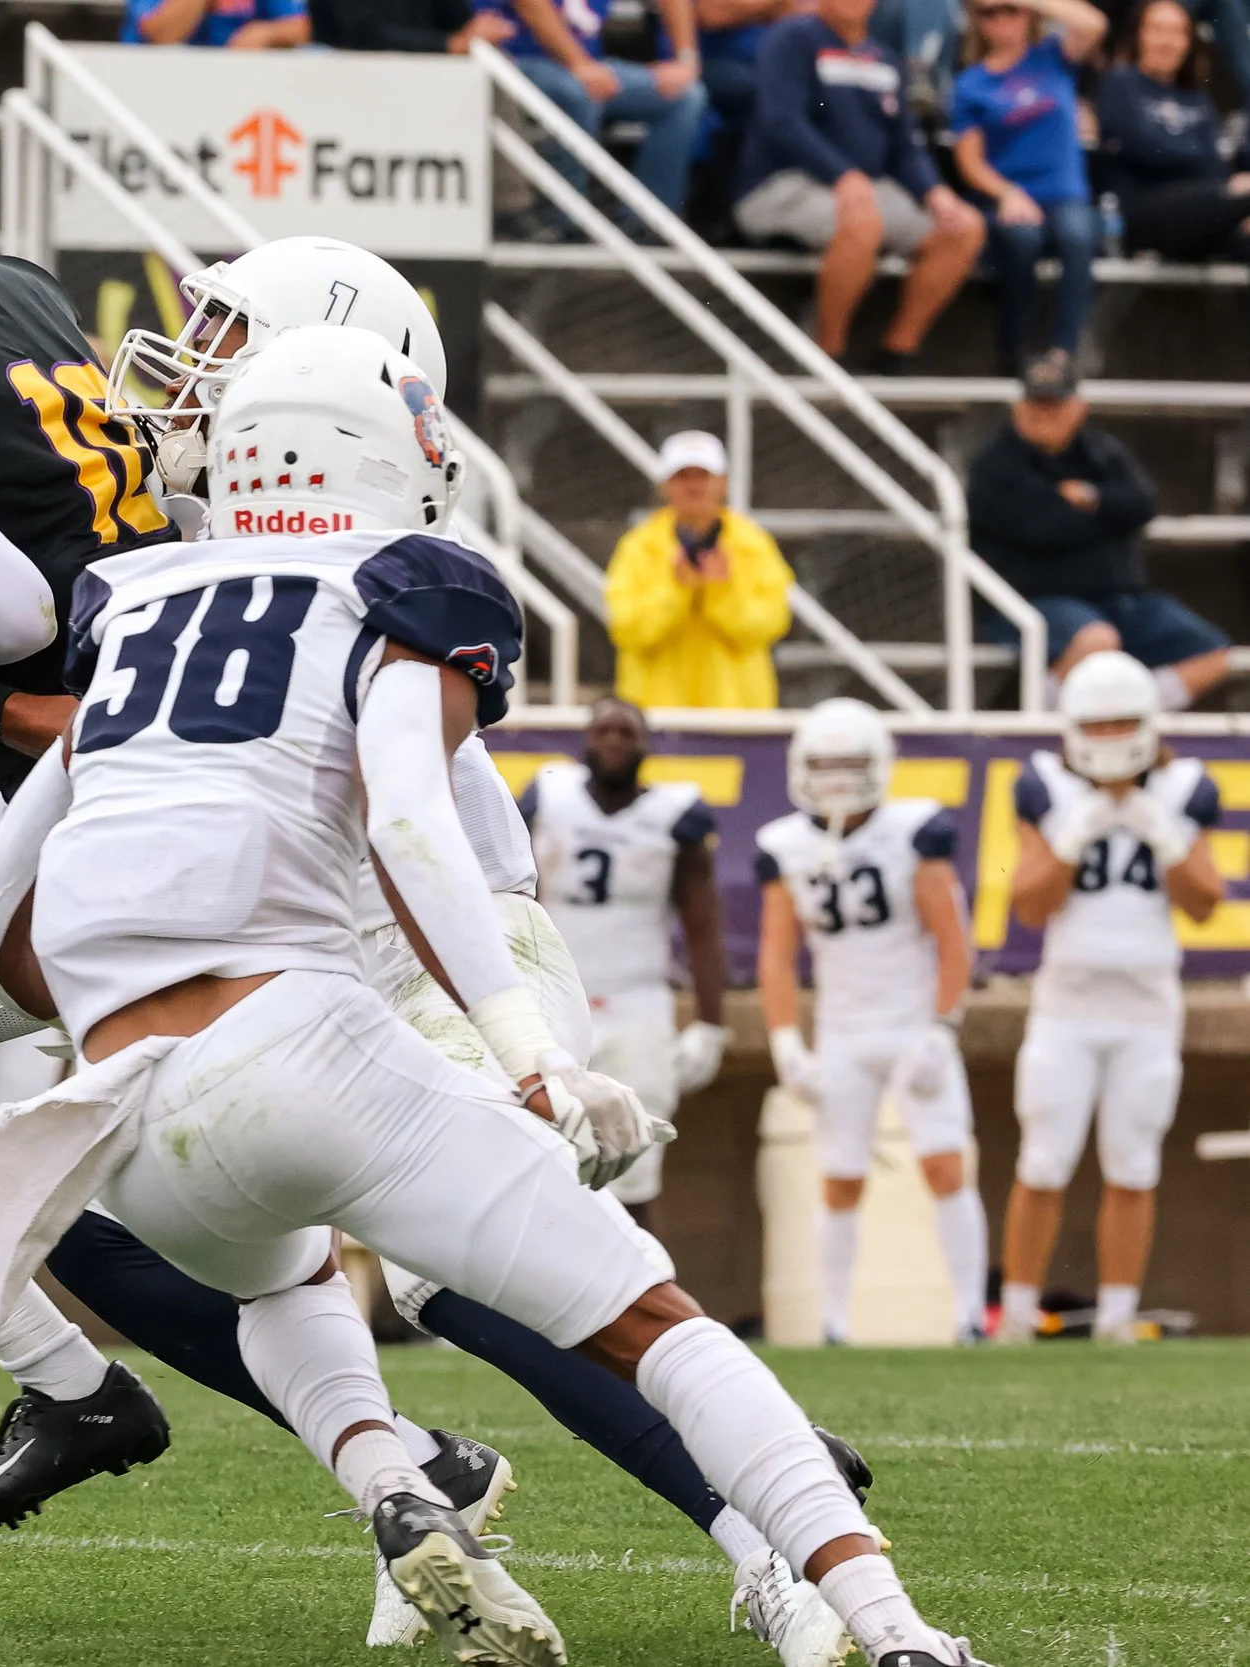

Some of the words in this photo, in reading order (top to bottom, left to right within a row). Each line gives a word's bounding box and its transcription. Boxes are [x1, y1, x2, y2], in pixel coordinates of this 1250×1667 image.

[309, 139, 469, 203] Farm
[324, 280, 359, 326] 1
[234, 508, 353, 535] Riddell
[74, 574, 319, 754] 38
[565, 848, 611, 905] 3
[1072, 838, 1159, 892] 84
[807, 865, 890, 935] 33
